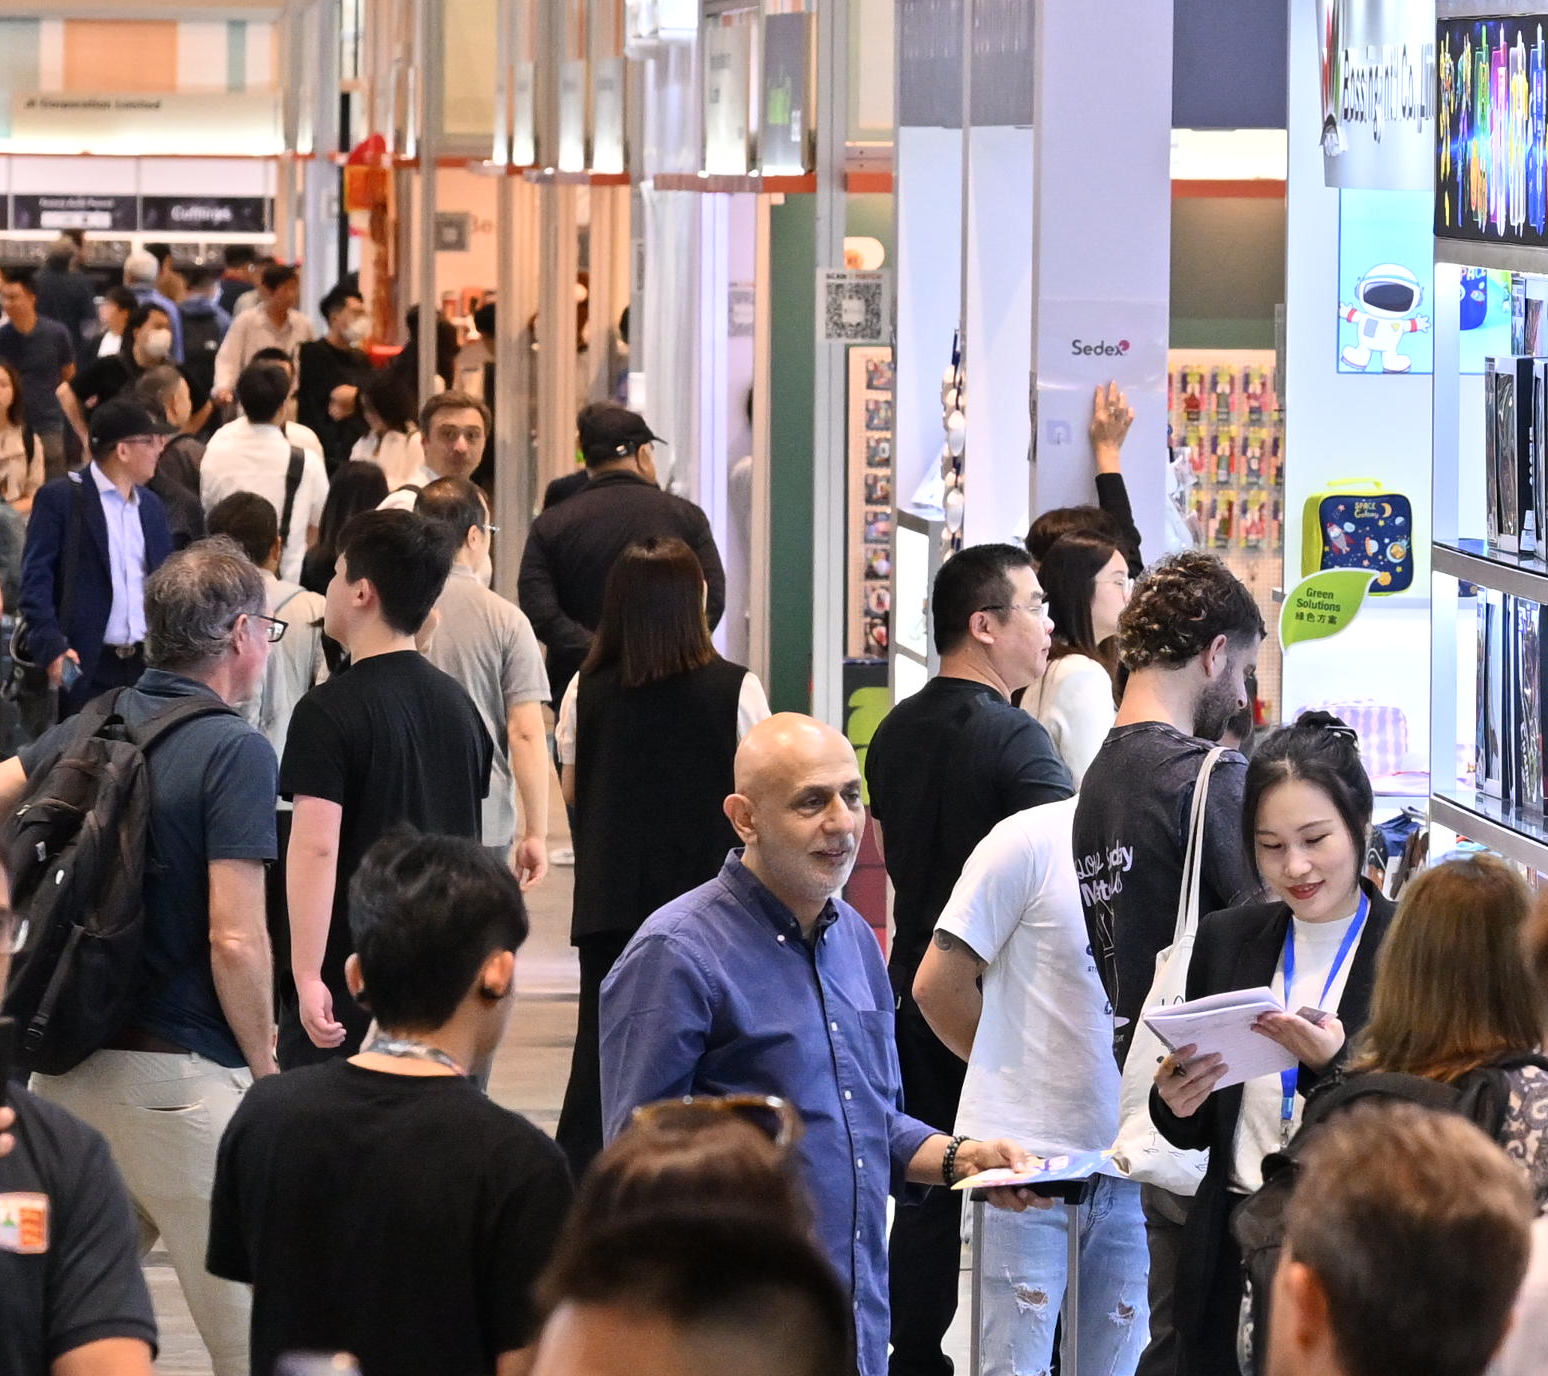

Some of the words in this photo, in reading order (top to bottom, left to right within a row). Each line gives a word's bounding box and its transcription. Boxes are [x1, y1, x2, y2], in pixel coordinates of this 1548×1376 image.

[1071, 339, 1124, 357] Sedex
[1306, 587, 1334, 600] Green
[1296, 599, 1341, 612] Solutions
